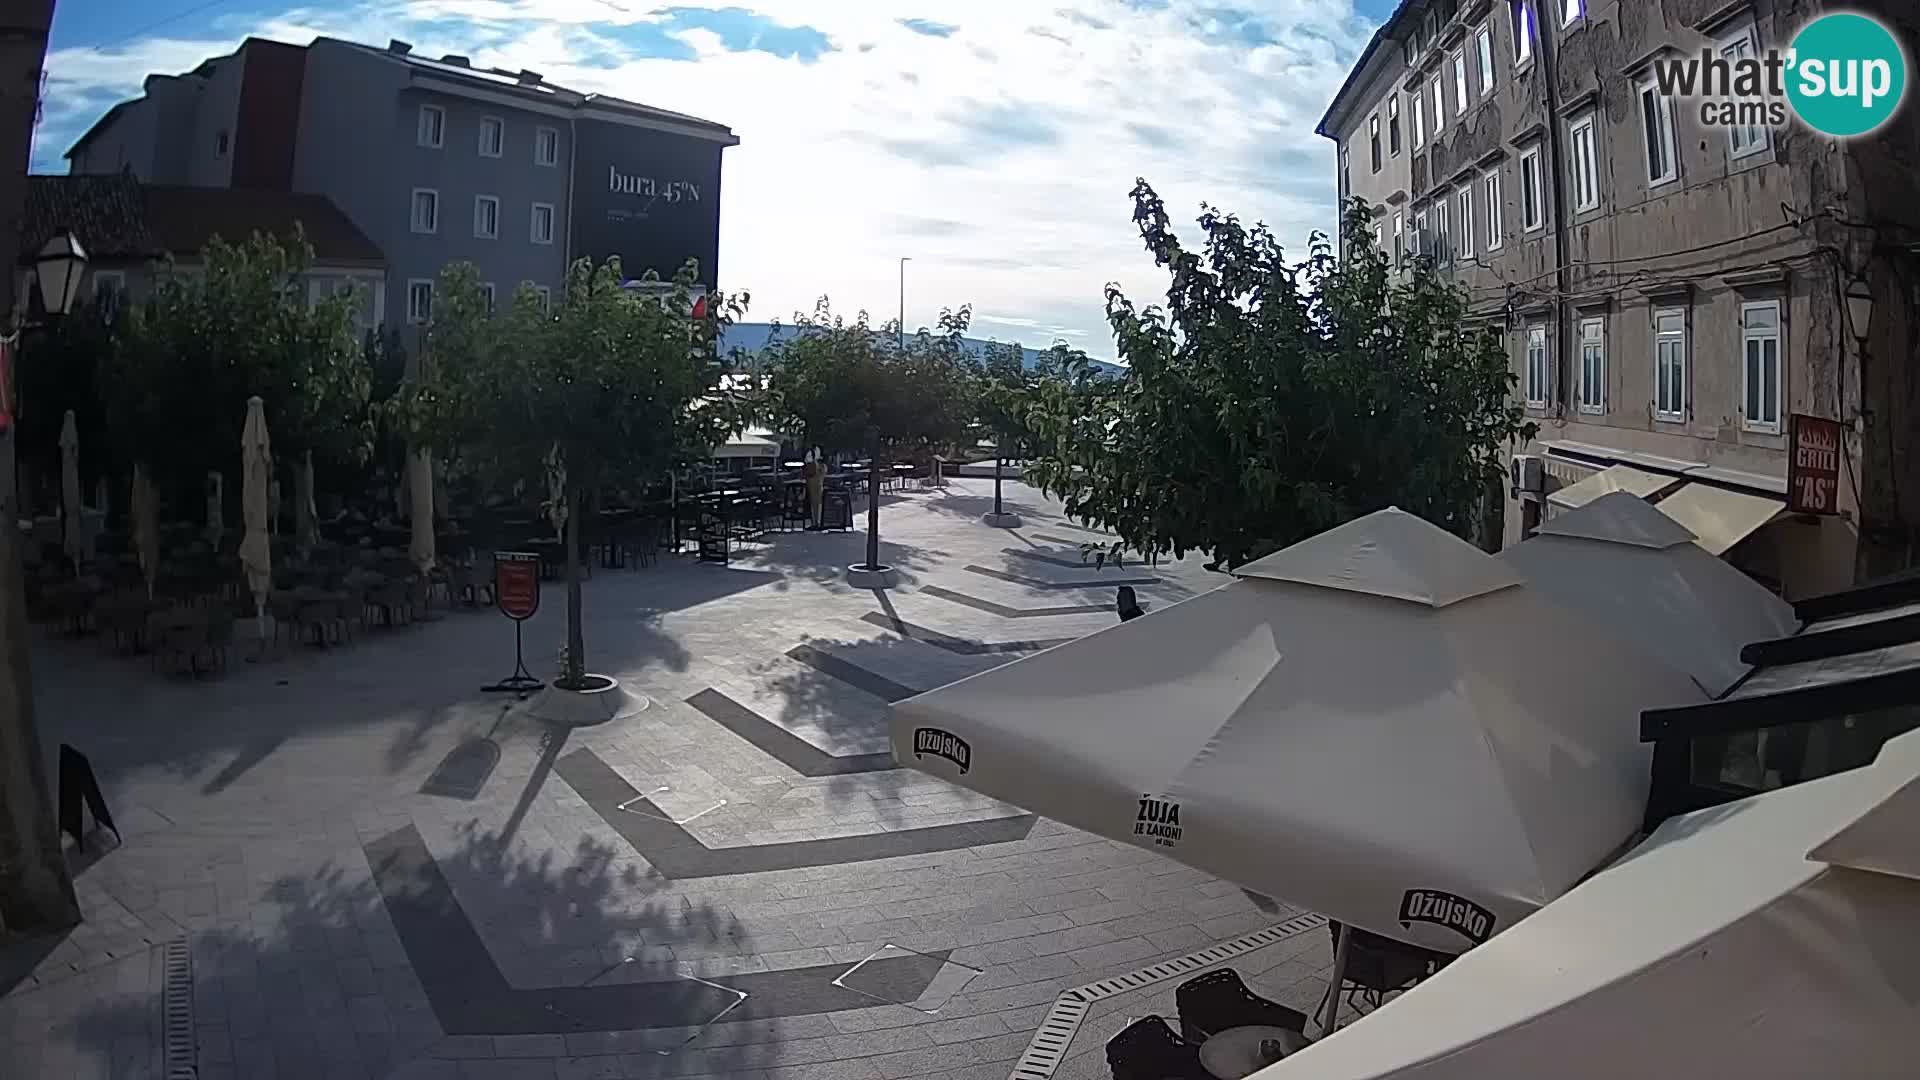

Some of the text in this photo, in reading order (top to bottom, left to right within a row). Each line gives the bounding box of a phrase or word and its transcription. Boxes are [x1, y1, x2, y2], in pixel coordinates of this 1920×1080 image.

[609, 165, 656, 196] bura
[1797, 447, 1837, 471] GRILL
[918, 730, 966, 763] Ožujsko
[1137, 793, 1180, 825] ŽUJA
[1407, 892, 1487, 938] Ožujsko
